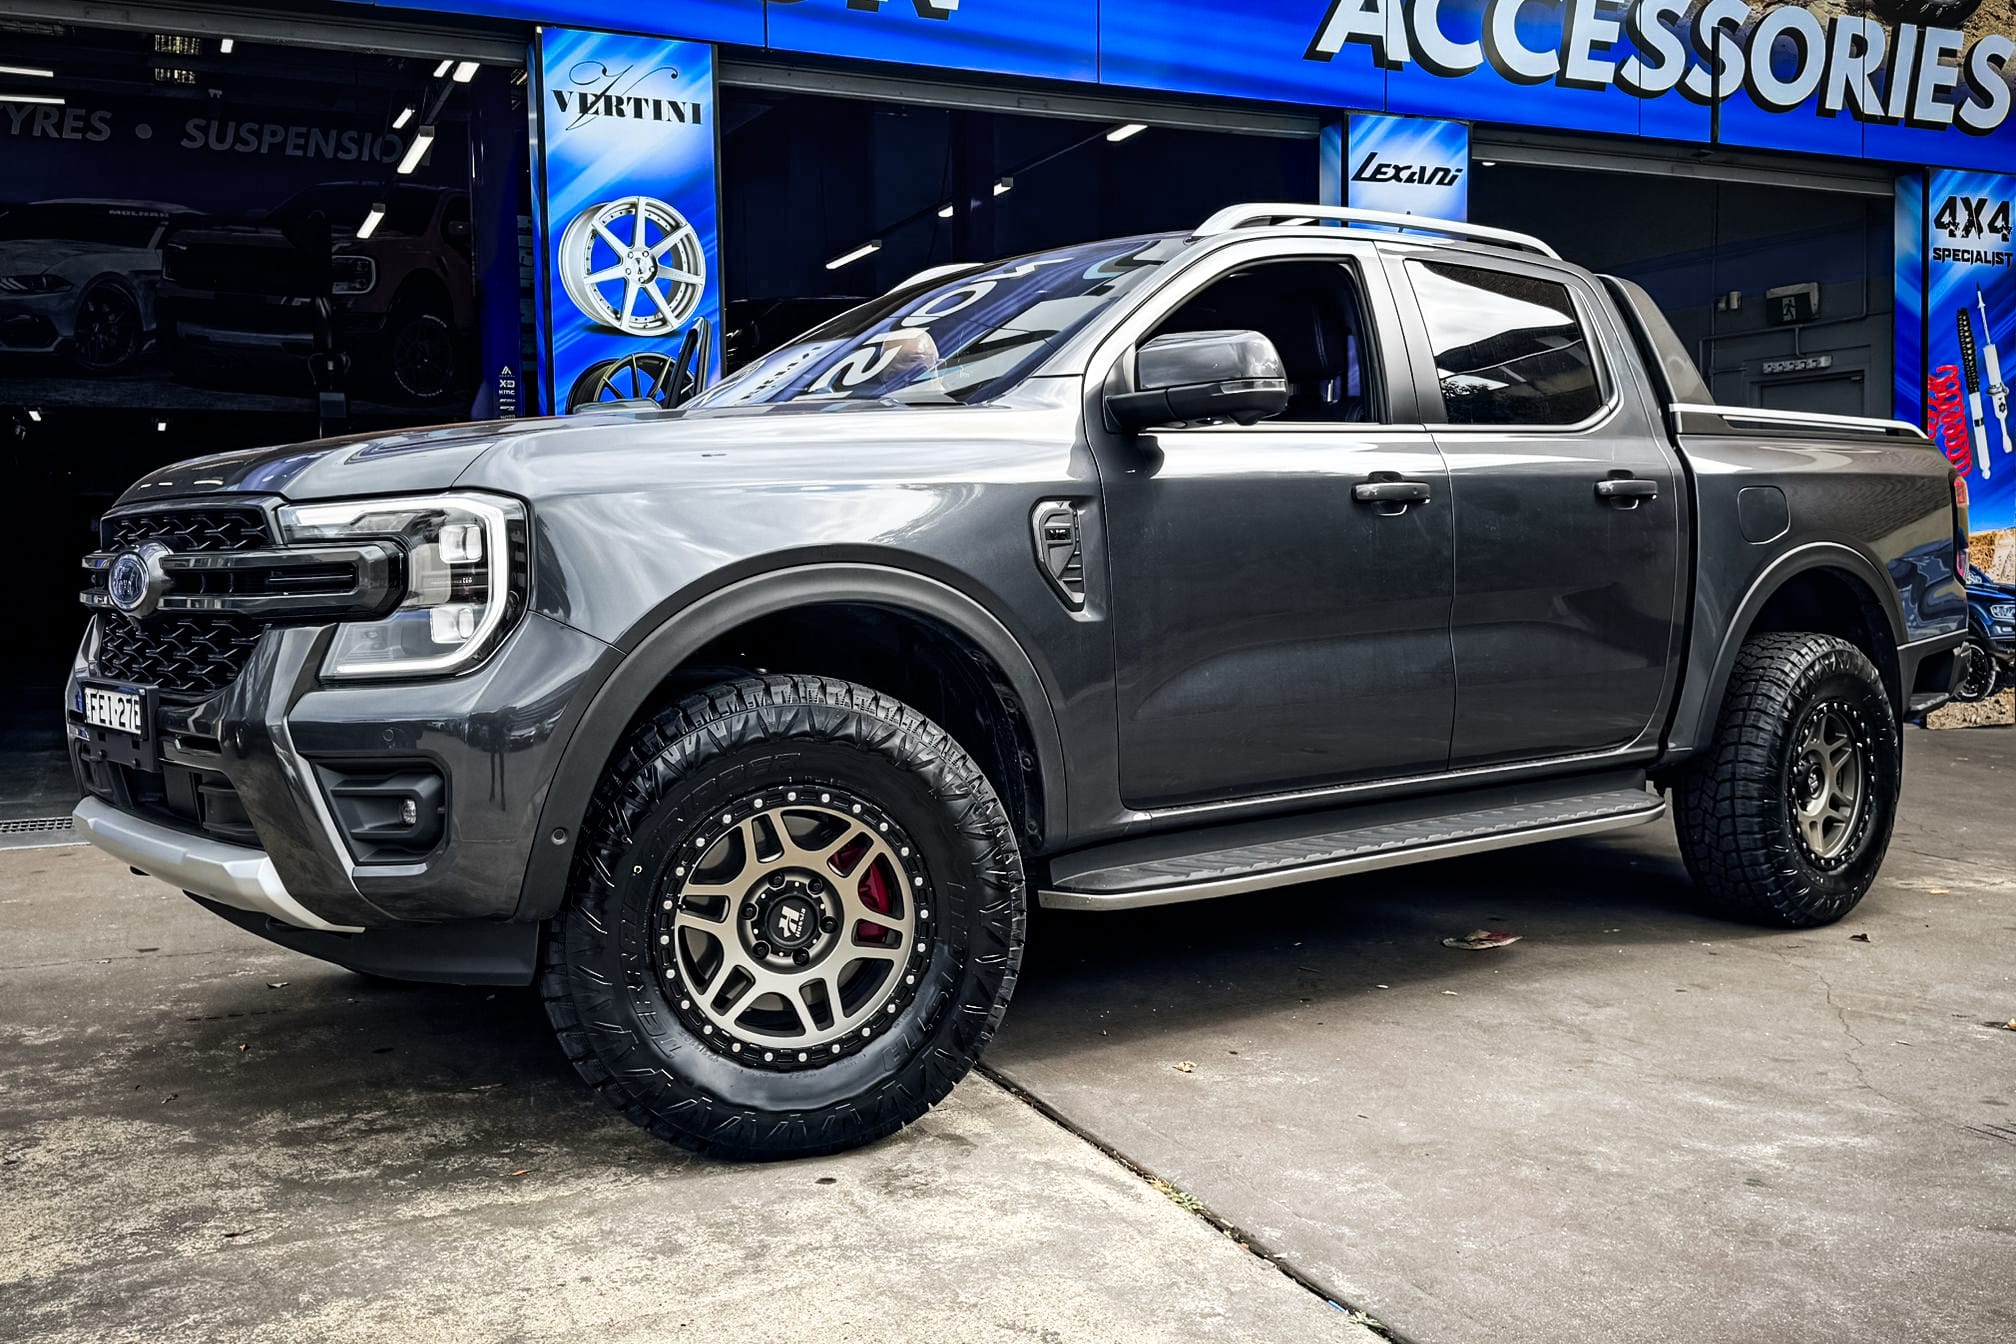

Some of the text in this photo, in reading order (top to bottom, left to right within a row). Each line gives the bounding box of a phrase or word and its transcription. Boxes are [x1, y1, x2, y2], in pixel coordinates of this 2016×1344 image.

[1305, 0, 2015, 135] ACCESSORIES
[552, 90, 702, 125] VERTINI
[0, 103, 434, 167] YRES SUSPENSIO
[1933, 195, 2013, 242] 4X4
[1933, 247, 2014, 268] SPECIALIST
